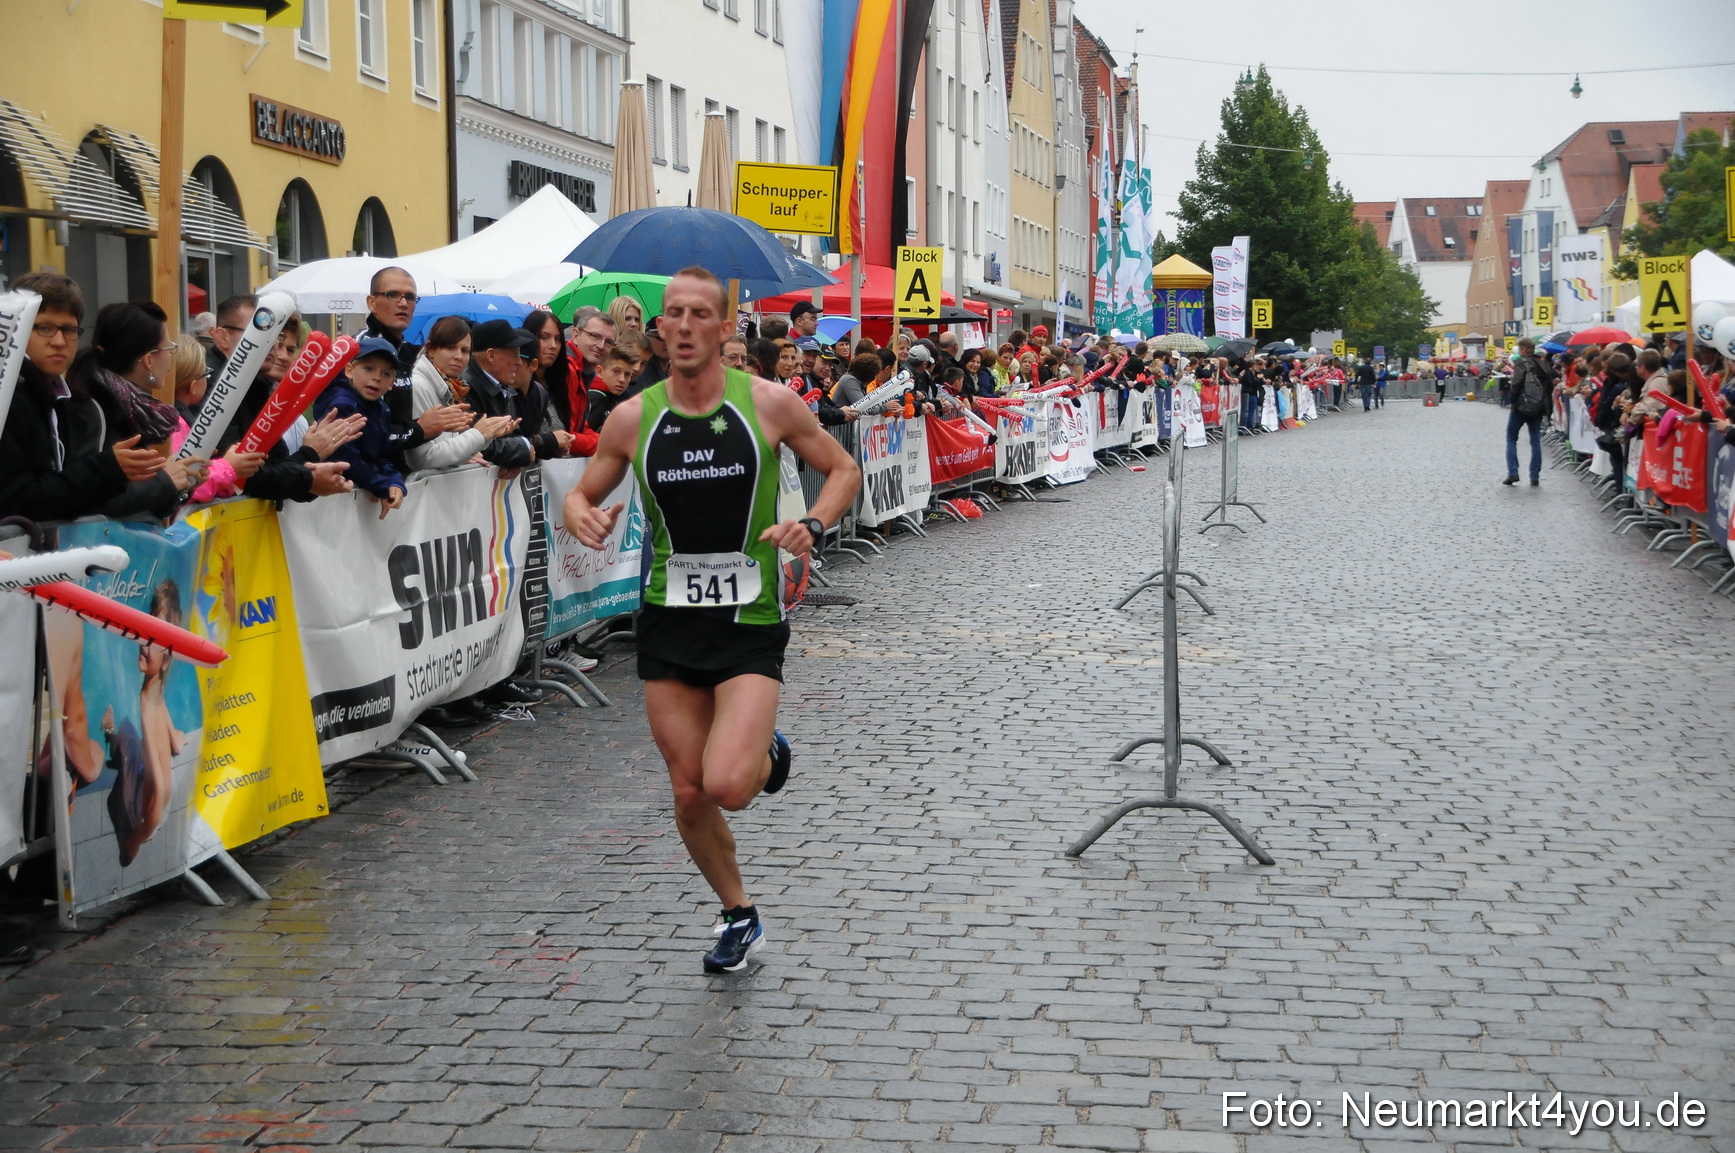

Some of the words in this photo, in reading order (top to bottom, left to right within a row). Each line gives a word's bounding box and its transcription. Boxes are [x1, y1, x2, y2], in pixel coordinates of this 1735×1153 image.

[742, 182, 828, 201] Schnupper-
[770, 203, 798, 217] lauf
[902, 249, 937, 262] Block
[1645, 260, 1685, 275] Block
[905, 268, 931, 302] A
[1651, 280, 1681, 316] A
[1257, 309, 1267, 321] B
[1539, 306, 1549, 320] B
[174, 337, 260, 462] bmw-laufsport.d
[256, 394, 288, 433] BKK
[683, 449, 715, 463] DAV
[657, 462, 745, 482] Röthenbach
[668, 560, 697, 570] PARTL
[699, 560, 742, 569] Neumarkt
[388, 527, 487, 650] swn
[687, 573, 739, 604] 541
[348, 695, 391, 720] verbinden
